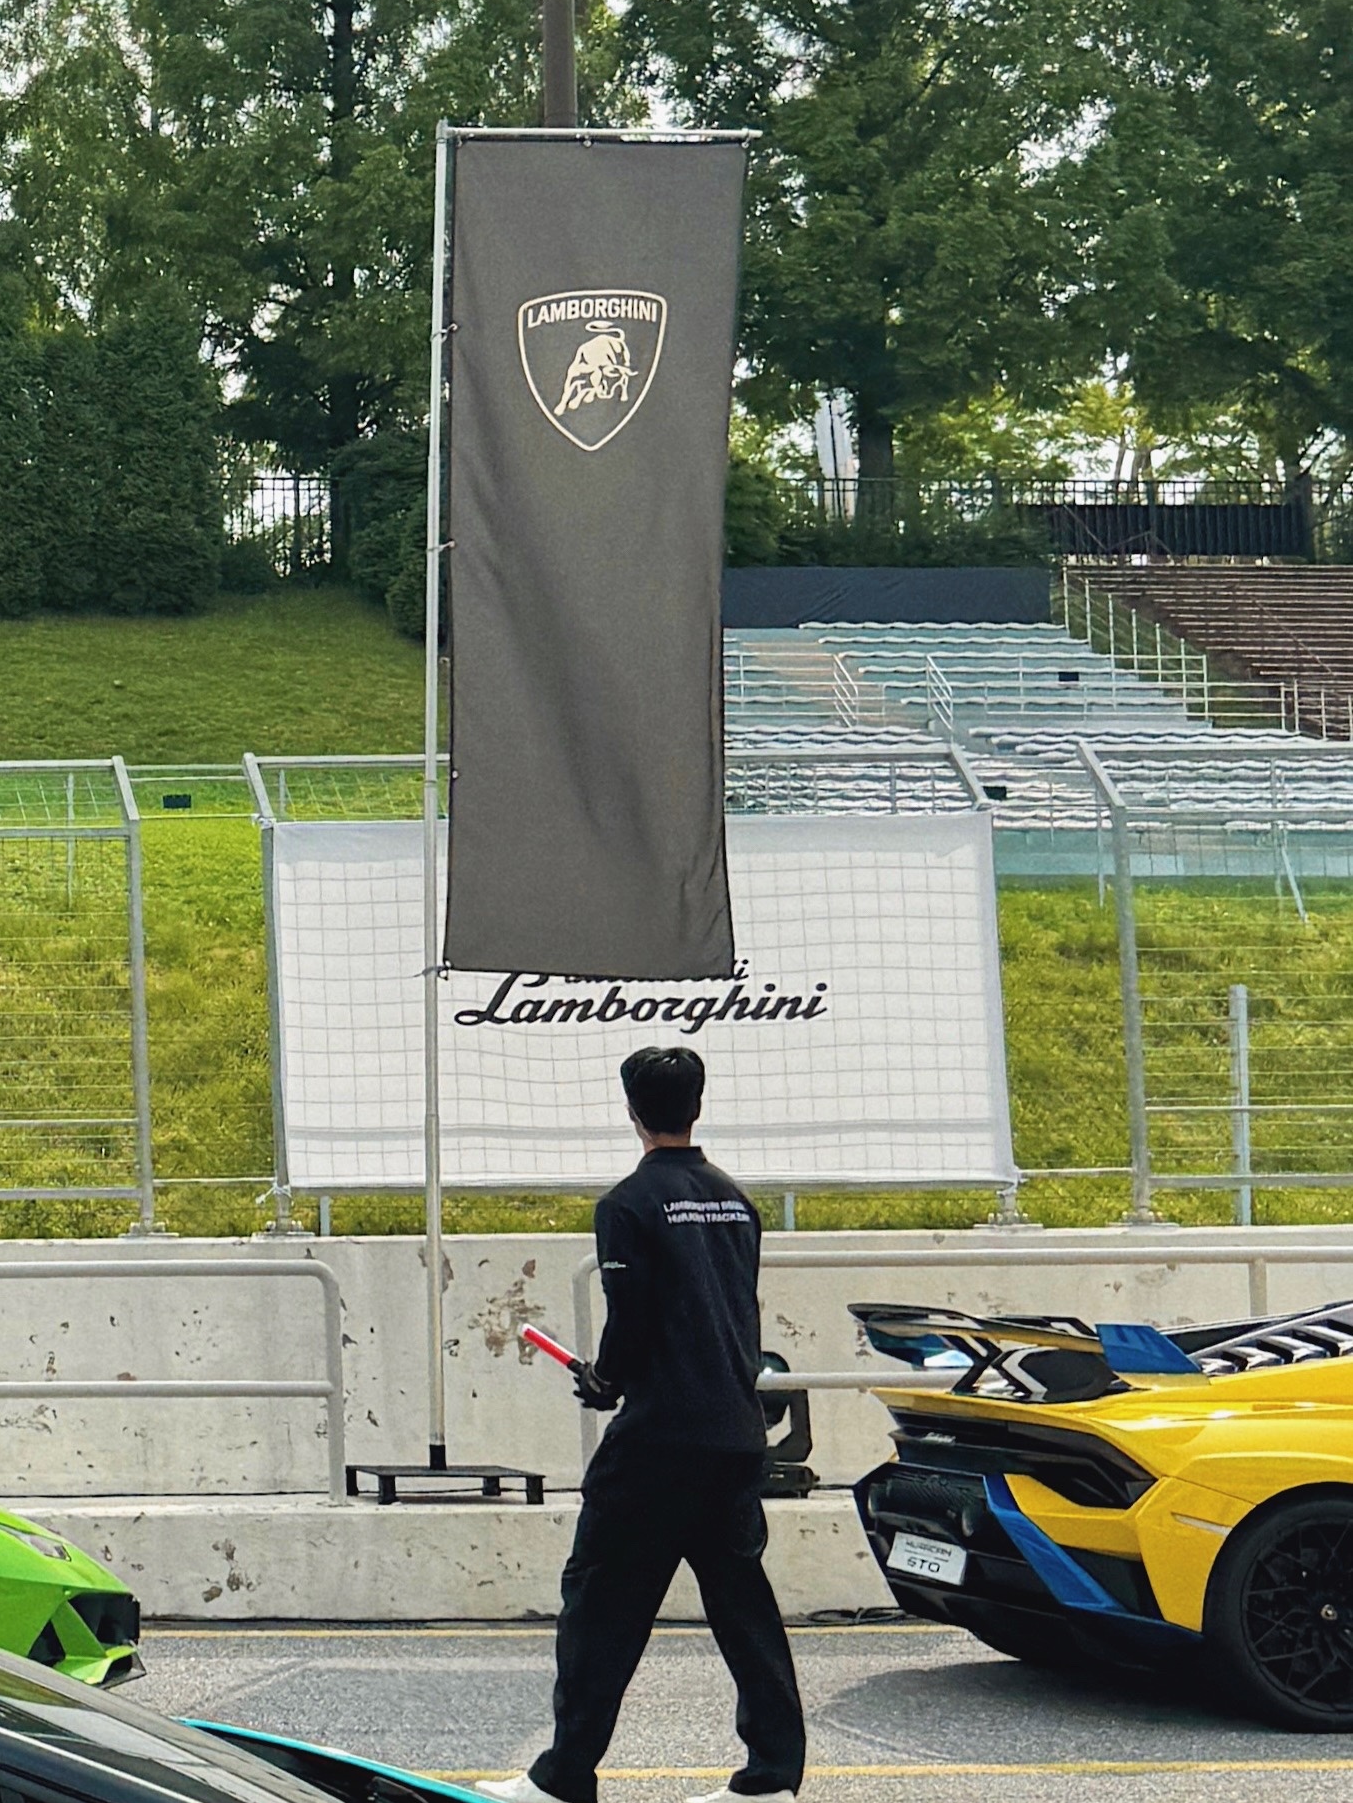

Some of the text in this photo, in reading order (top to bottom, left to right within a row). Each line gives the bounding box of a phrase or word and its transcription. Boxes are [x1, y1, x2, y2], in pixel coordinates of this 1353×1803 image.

[527, 298, 658, 329] LAMBORGHINI
[454, 971, 829, 1035] Lamborghini
[906, 1556, 941, 1574] STO
